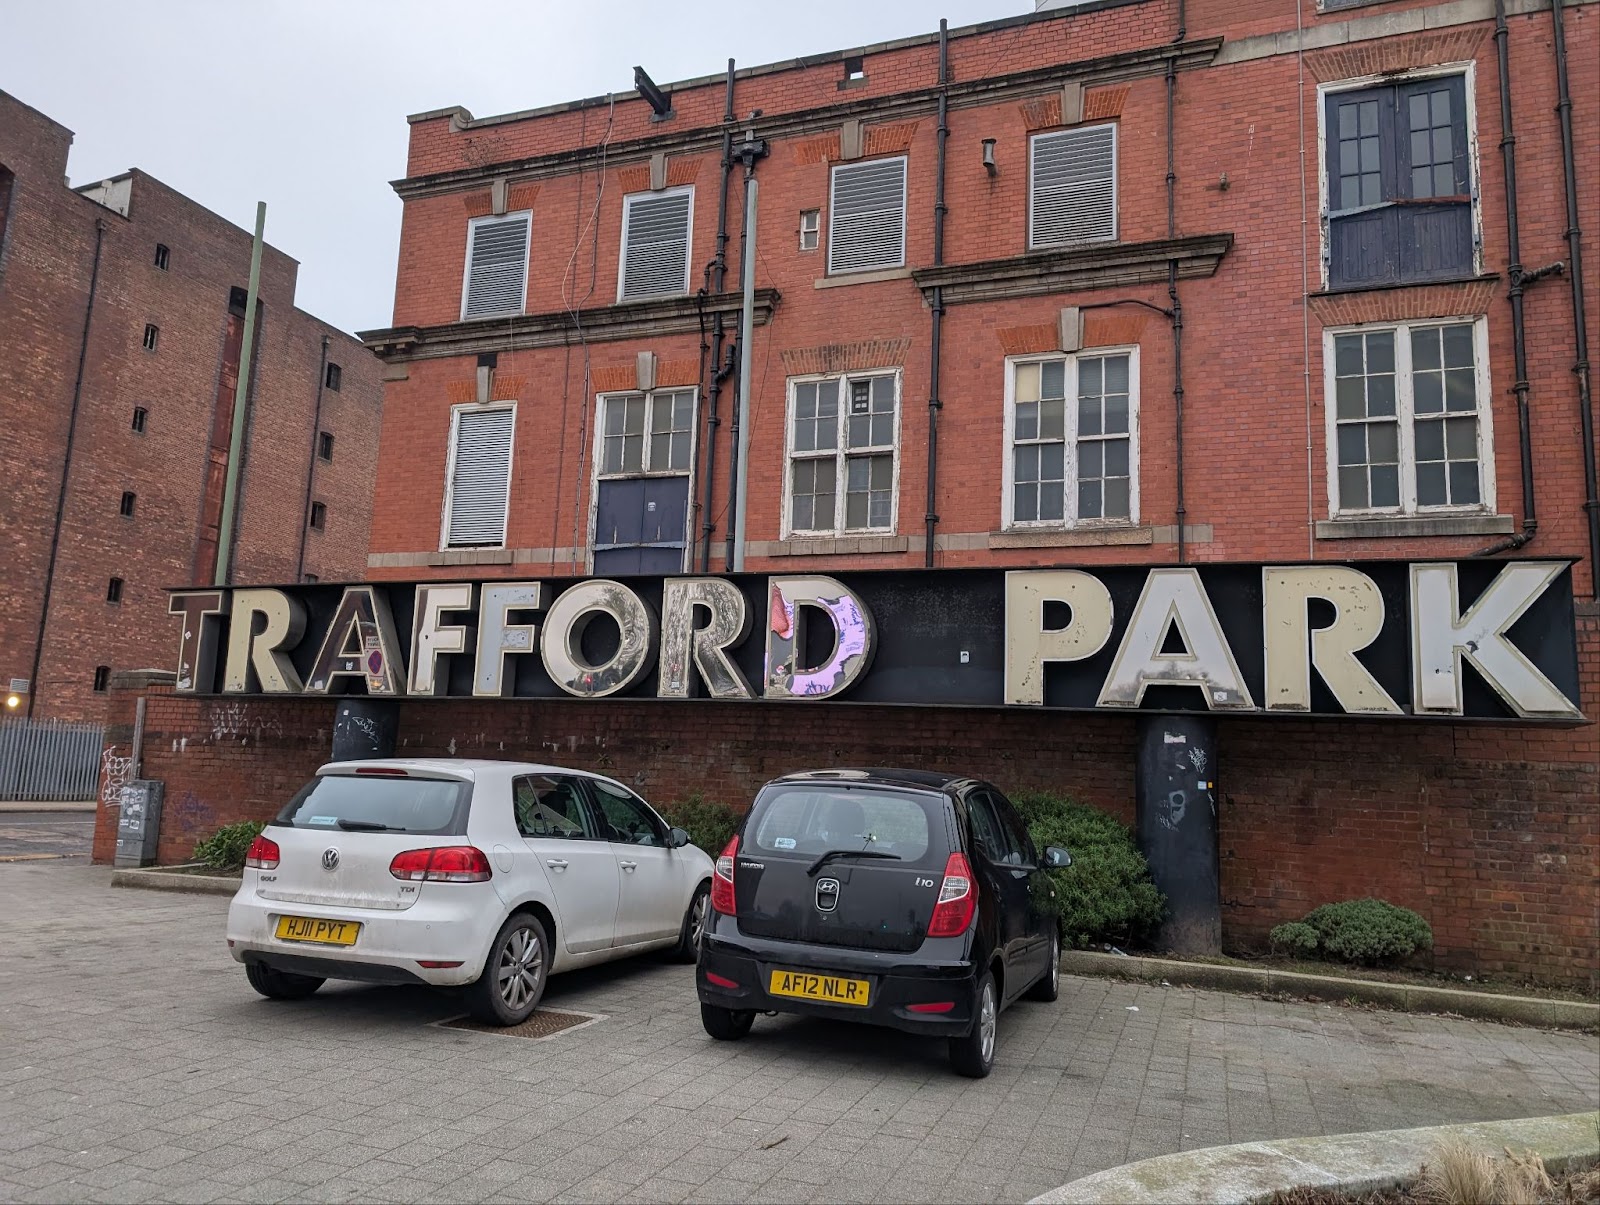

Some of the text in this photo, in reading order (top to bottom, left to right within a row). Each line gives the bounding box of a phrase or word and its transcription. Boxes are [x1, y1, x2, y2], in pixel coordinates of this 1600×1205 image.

[168, 561, 1586, 720] TRAFFORD PARK
[915, 877, 934, 888] i10
[287, 919, 347, 940] HJ11 PYT
[781, 976, 857, 999] AF12 NLR
